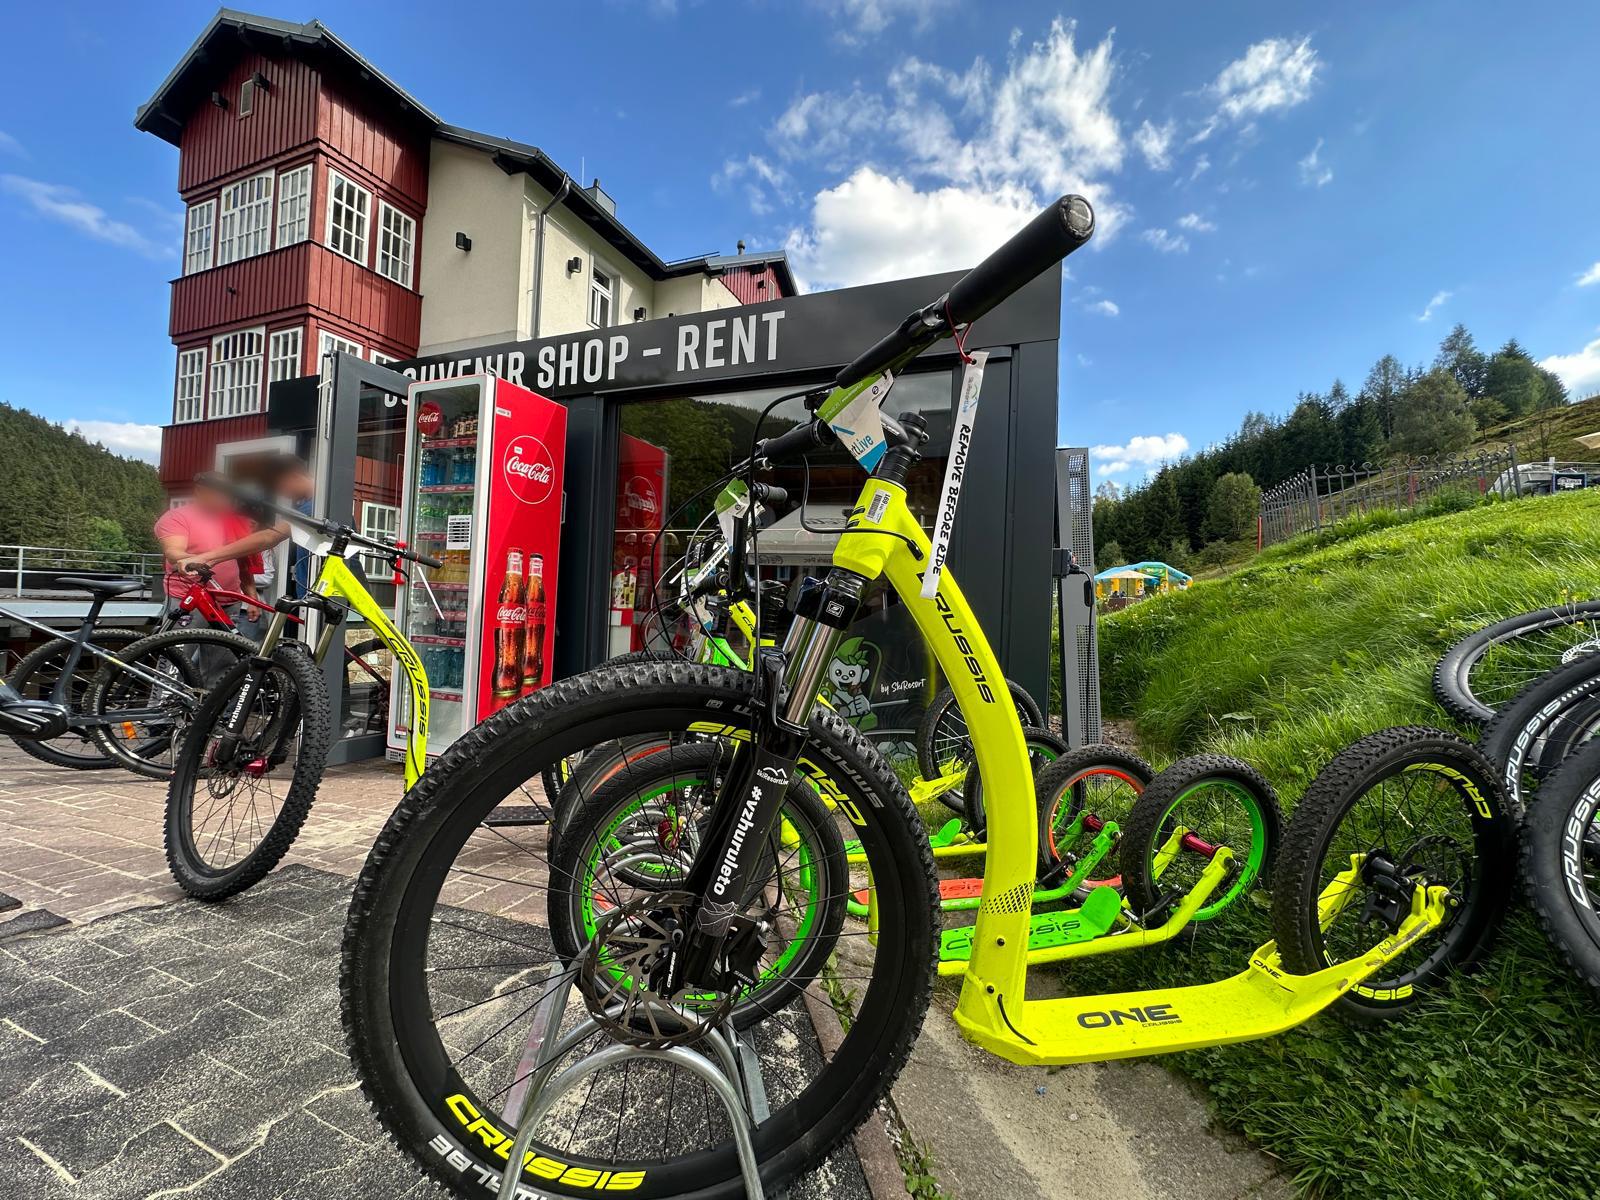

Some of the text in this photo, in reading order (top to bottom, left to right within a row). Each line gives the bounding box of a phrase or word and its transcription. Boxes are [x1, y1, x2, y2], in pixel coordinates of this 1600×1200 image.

[537, 338, 629, 389] SHOP
[677, 310, 786, 372] RENT
[506, 455, 552, 484] Coca-Cola
[933, 424, 971, 576] REMOVE BEFORE RIDE
[916, 571, 996, 703] RUSSIS
[228, 683, 251, 729] #vzhuruleto
[880, 678, 927, 695] by SkiResort
[808, 738, 885, 808] SMART
[713, 785, 763, 896] #vzhuruleto
[1253, 959, 1283, 979] ONE
[1077, 1003, 1180, 1029] ONE
[445, 1093, 647, 1190] CRUSSIS
